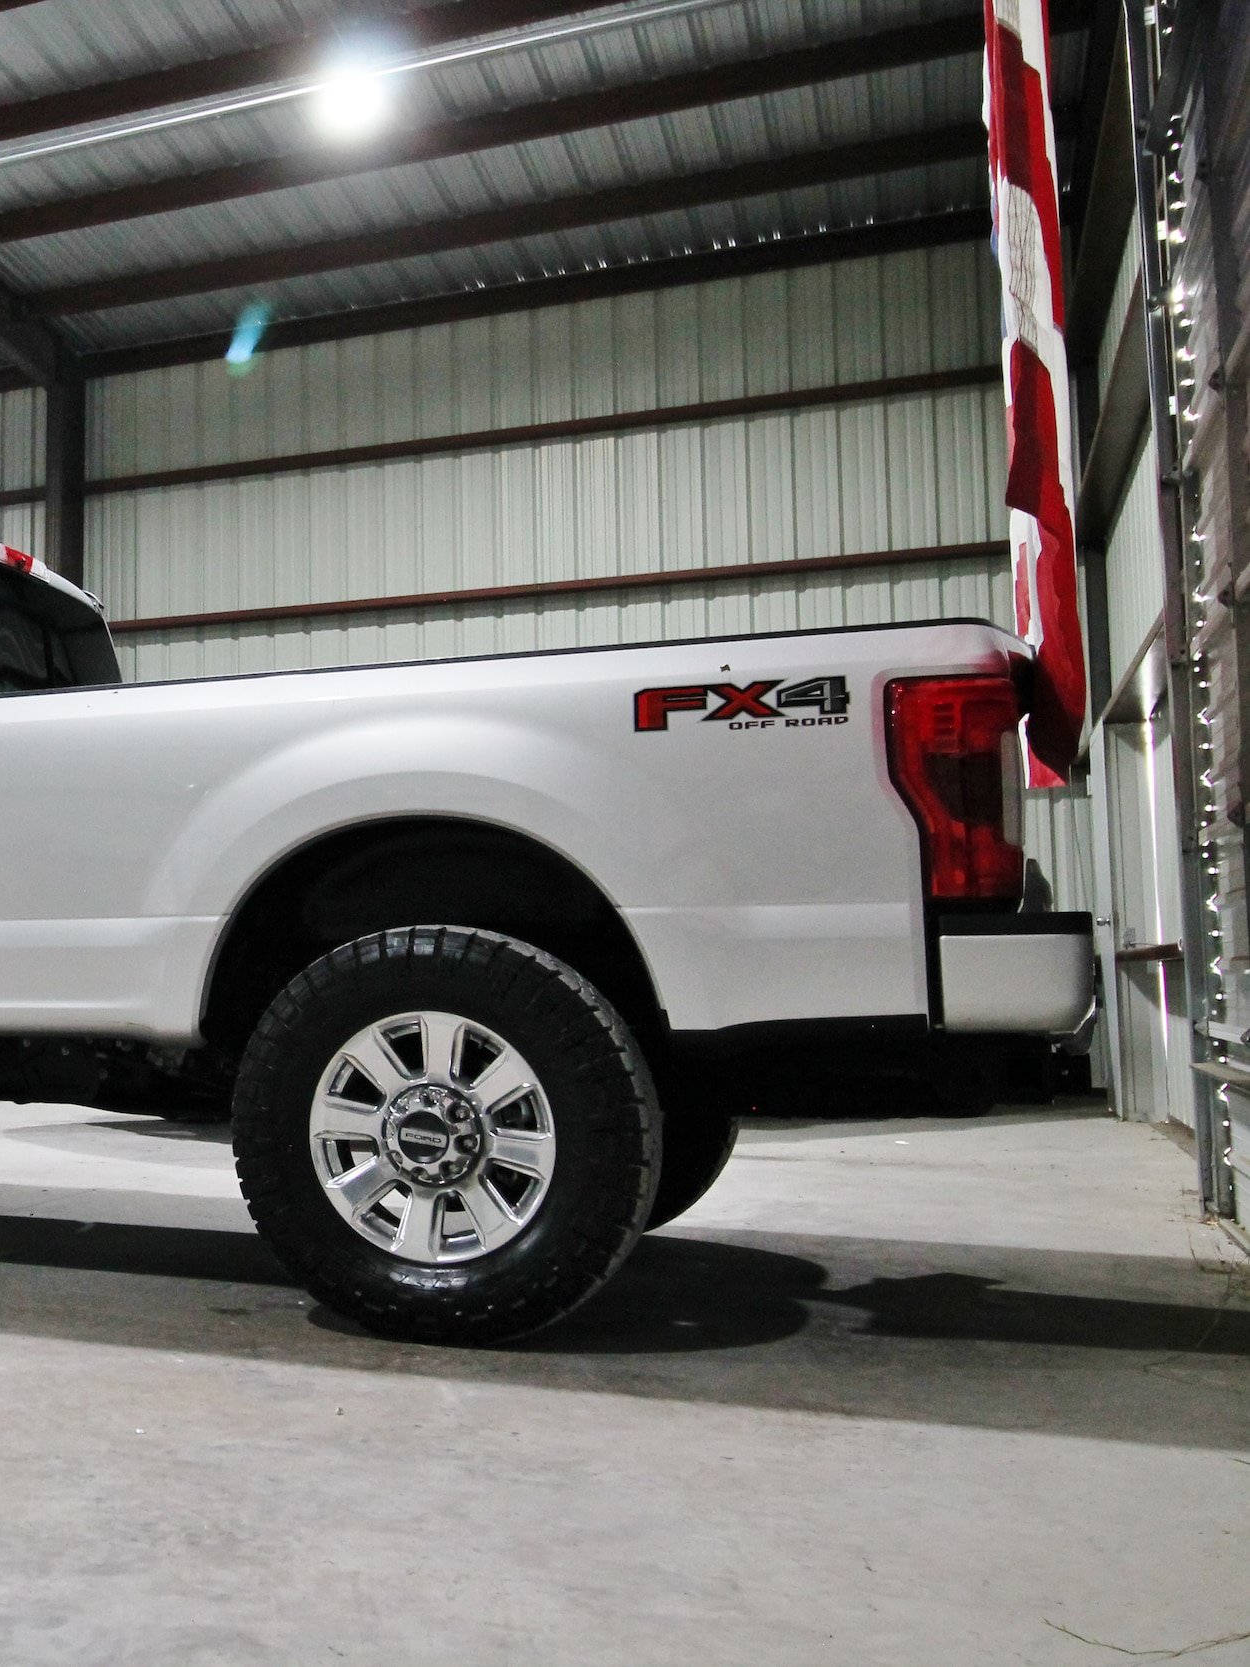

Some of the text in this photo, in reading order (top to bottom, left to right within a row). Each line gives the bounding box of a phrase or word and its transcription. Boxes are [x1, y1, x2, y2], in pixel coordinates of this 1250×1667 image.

[633, 675, 850, 732] FX4
[728, 716, 849, 730] OFF ROAD
[405, 1132, 442, 1144] FORD
